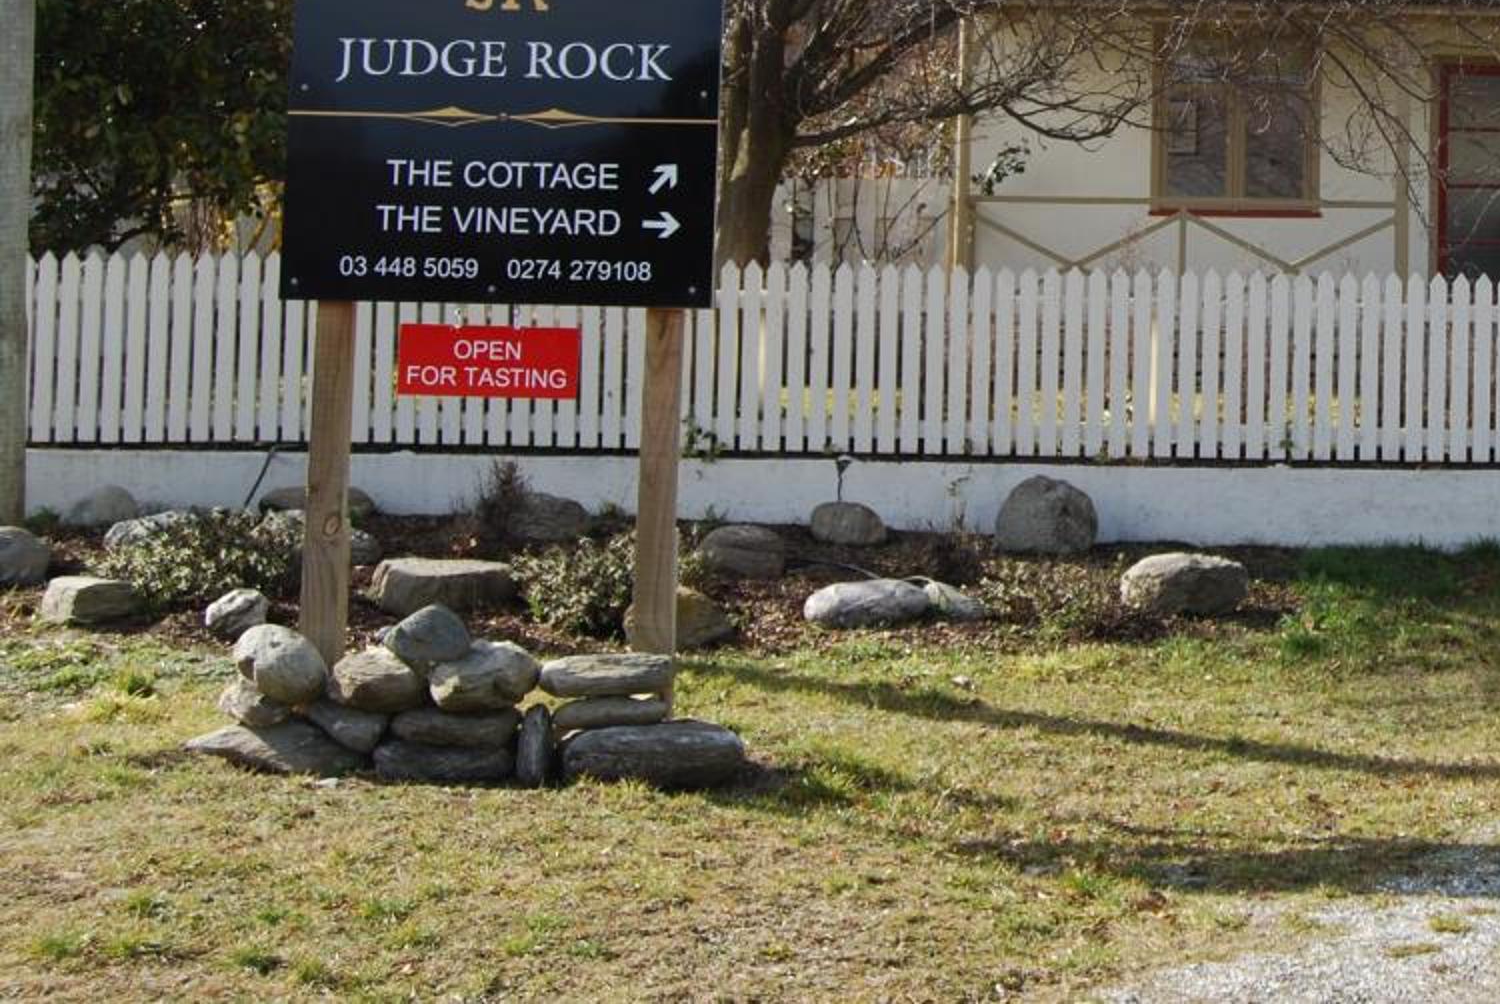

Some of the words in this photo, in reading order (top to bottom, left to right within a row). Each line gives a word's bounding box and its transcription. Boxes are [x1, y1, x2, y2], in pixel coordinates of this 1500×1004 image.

[335, 38, 508, 82] JUDGE
[525, 42, 673, 81] ROCK
[386, 160, 453, 187] THE
[463, 161, 619, 190] COTTAGE
[376, 205, 443, 233] THE
[452, 206, 621, 236] VINEYARD
[339, 255, 367, 277] 03
[373, 256, 416, 277] 448
[423, 257, 479, 279] 5059
[507, 259, 561, 280] 0274
[569, 260, 652, 281] 279108
[453, 340, 522, 361] OPEN
[406, 365, 457, 386] FOR
[464, 366, 567, 389] TASTING
